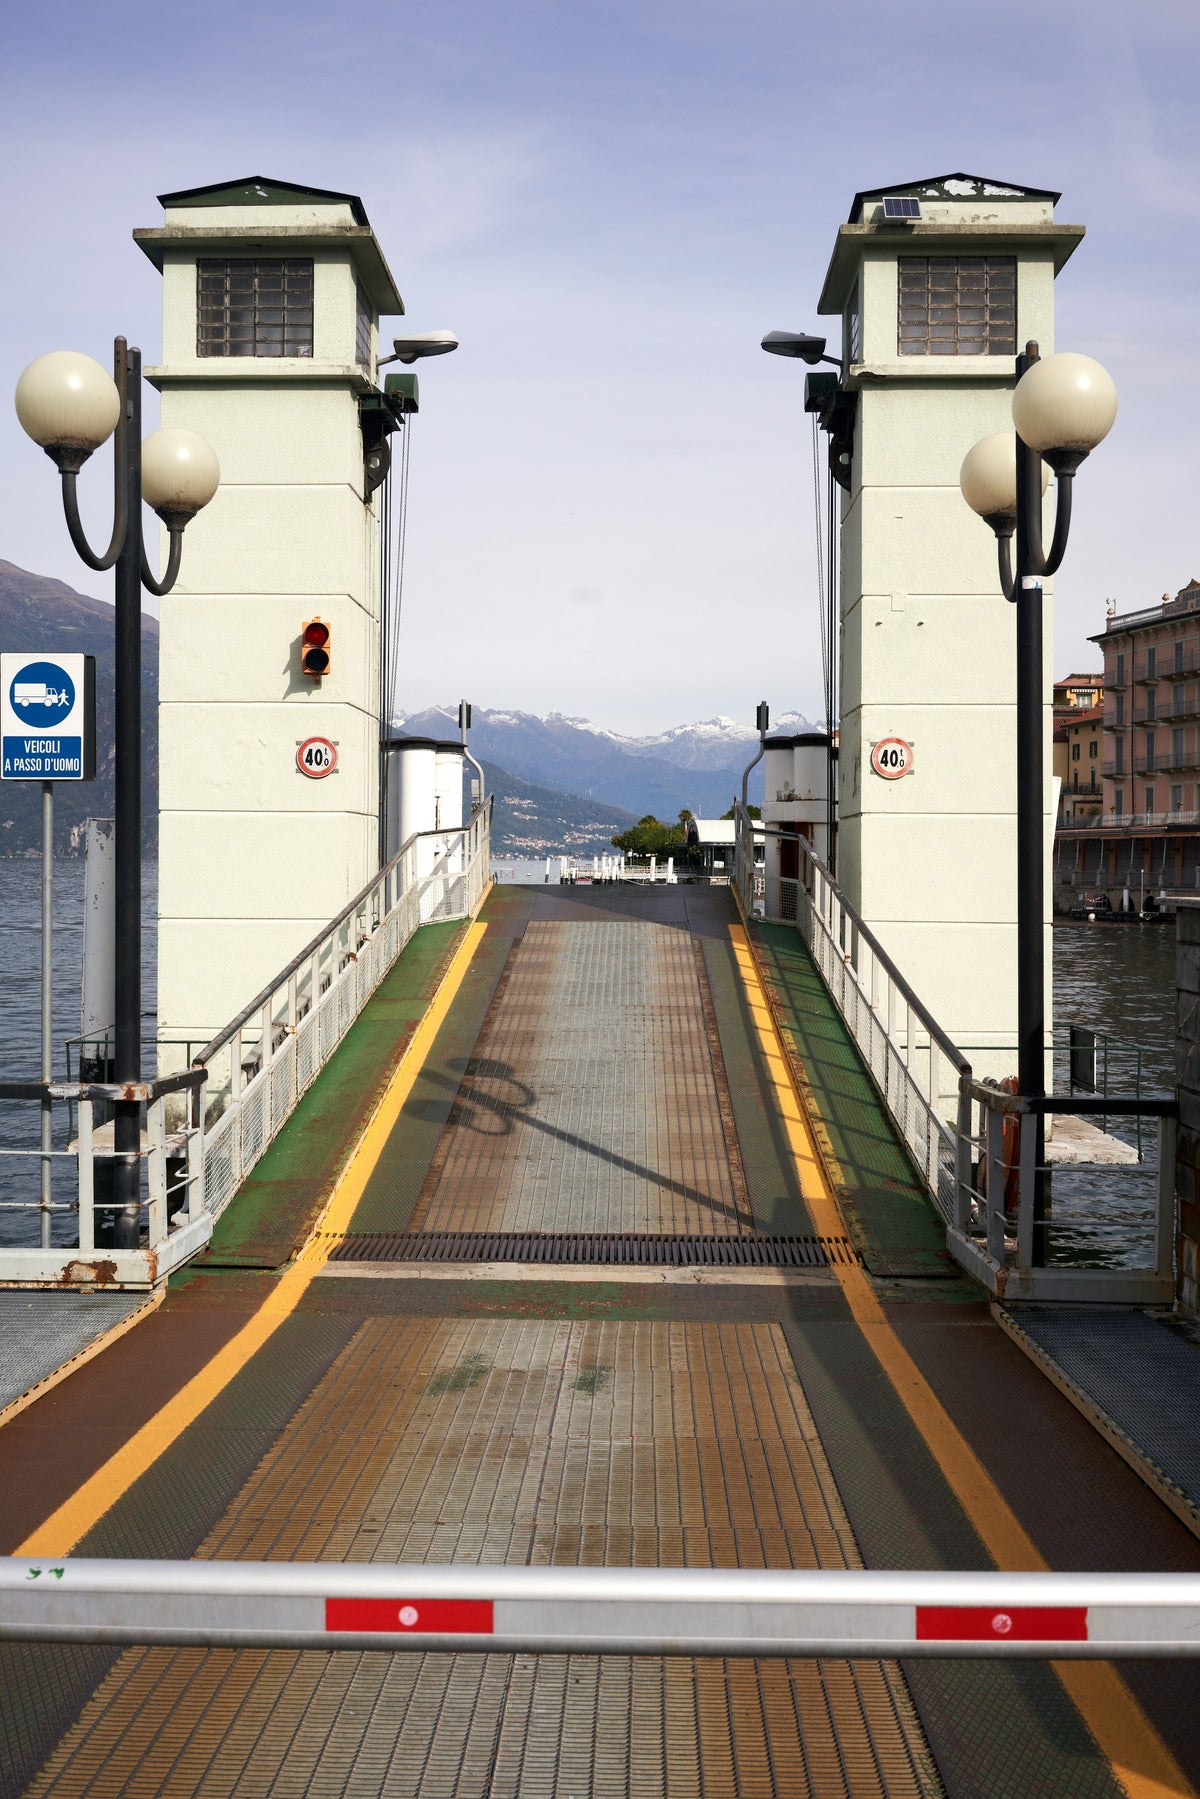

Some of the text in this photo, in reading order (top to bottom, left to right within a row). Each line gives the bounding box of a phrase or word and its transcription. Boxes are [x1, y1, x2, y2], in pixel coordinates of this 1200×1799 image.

[24, 740, 60, 754] VEICOLI
[4, 758, 80, 771] A PASSO D'UOMO
